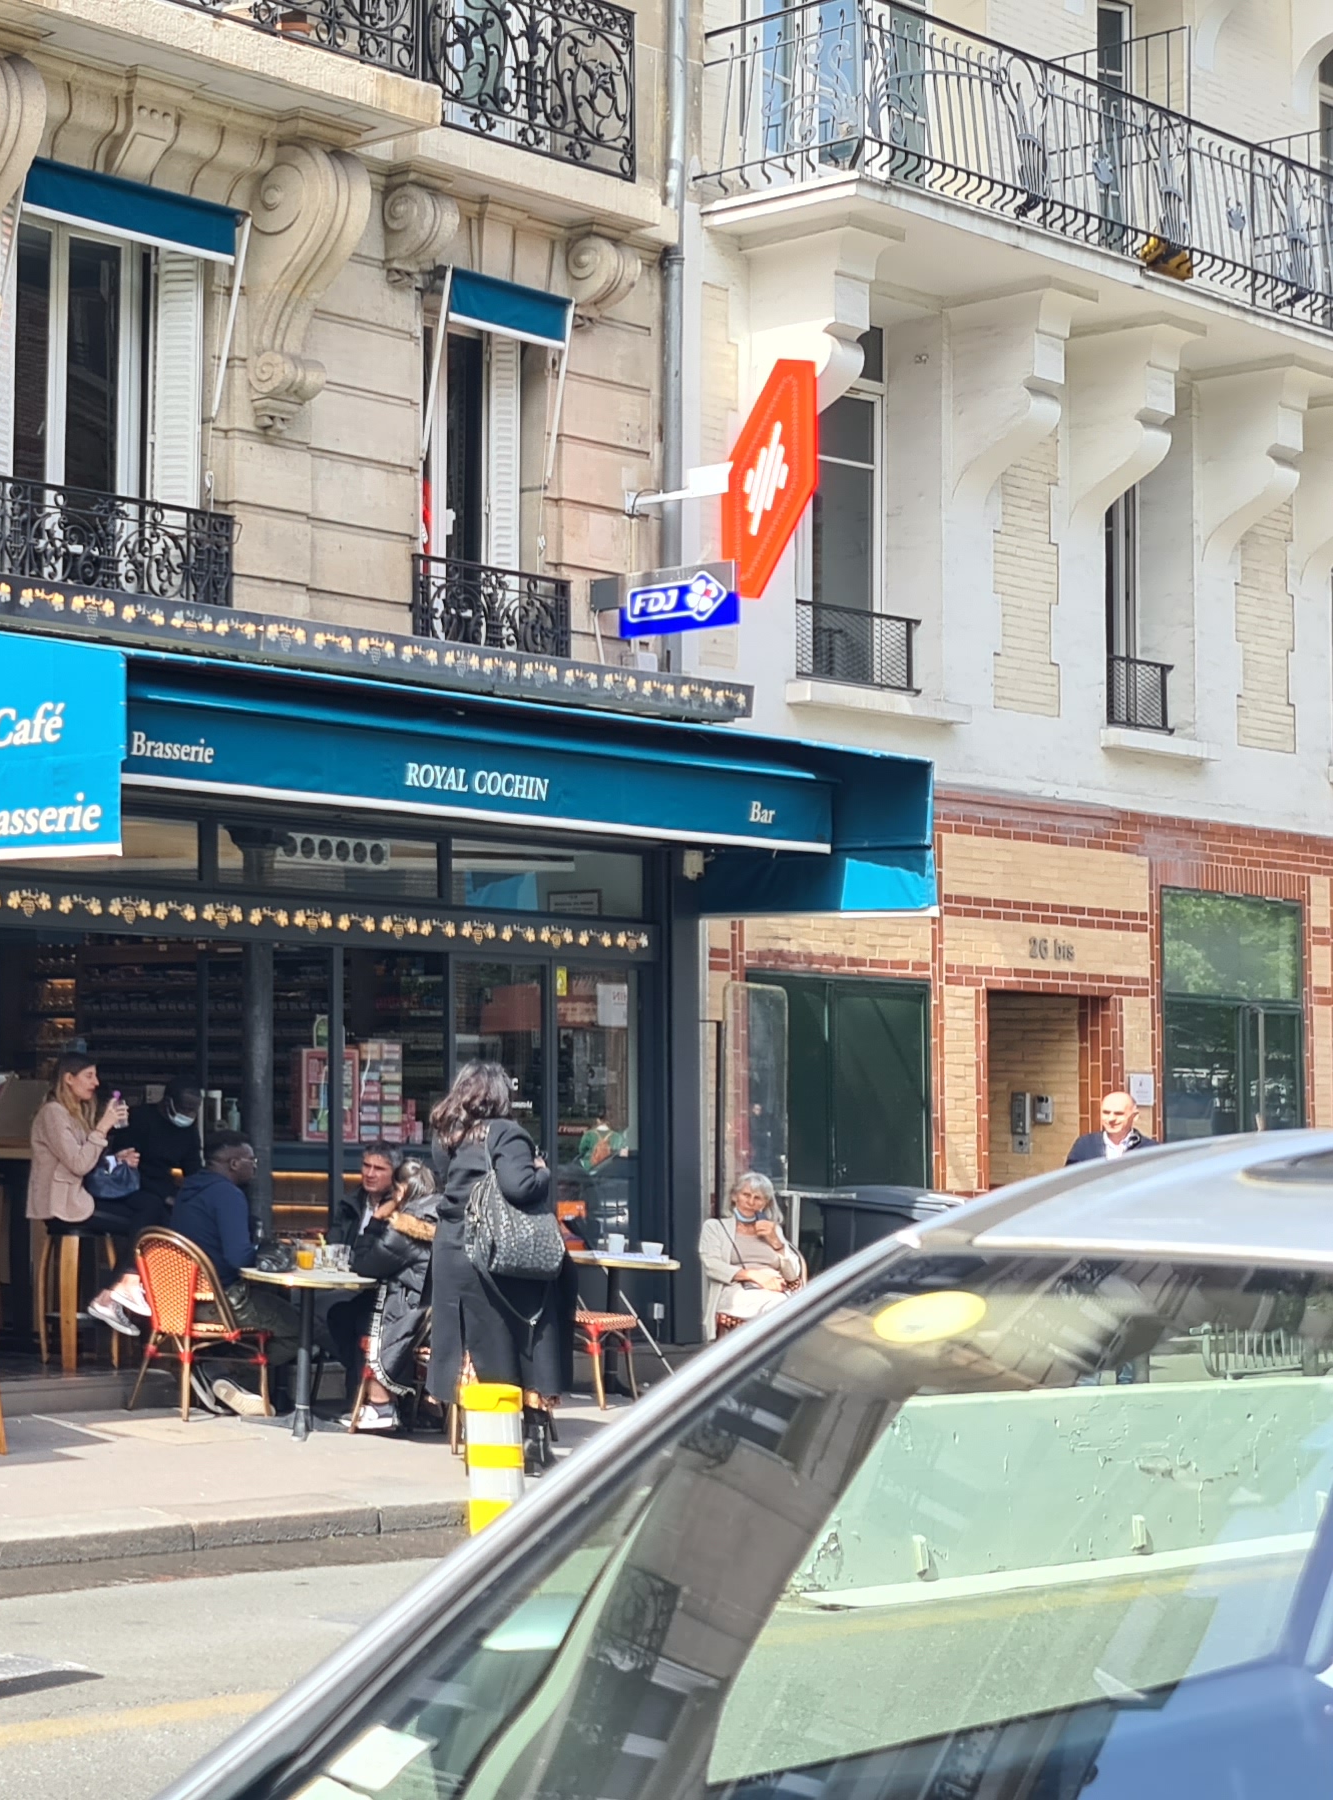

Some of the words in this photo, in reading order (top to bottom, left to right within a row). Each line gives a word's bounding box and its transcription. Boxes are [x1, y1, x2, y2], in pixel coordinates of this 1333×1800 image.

[633, 588, 678, 615] FDJ
[131, 731, 214, 764] Brasserie
[405, 763, 468, 792] ROYAL
[474, 770, 549, 801] COCHIN
[749, 801, 775, 824] Bar
[1028, 936, 1049, 960] 26
[1053, 939, 1075, 962] bis
